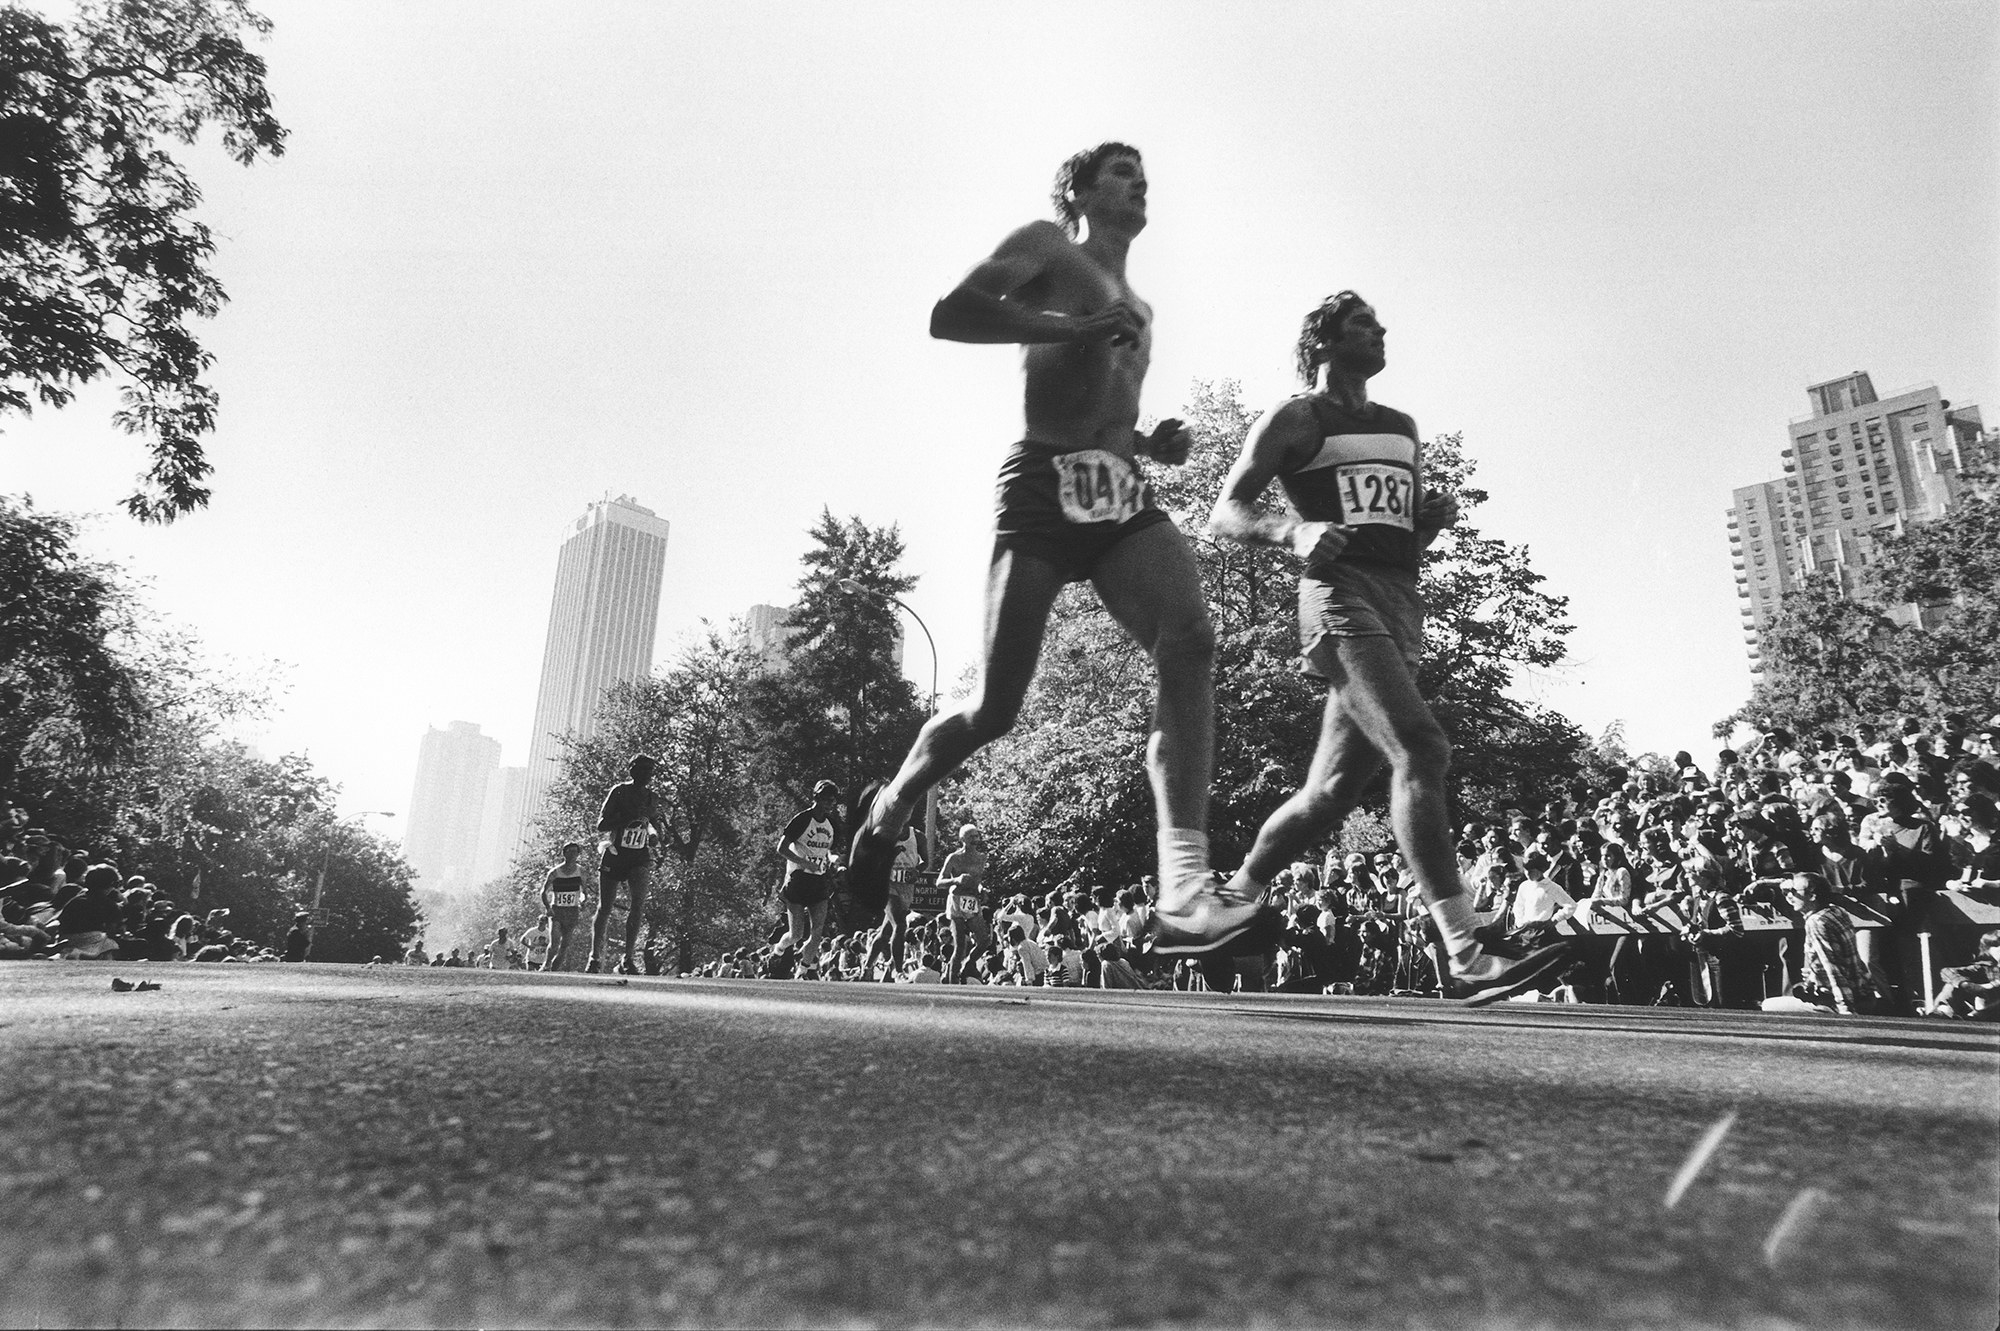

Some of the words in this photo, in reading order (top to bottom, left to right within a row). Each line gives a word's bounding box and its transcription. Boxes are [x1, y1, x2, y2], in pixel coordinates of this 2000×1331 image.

[1346, 474, 1411, 518] 1287
[806, 829, 816, 839] LE
[914, 877, 928, 885] ARK
[914, 887, 938, 895] NORTH
[558, 893, 576, 905] 1587
[912, 896, 924, 905] EEP
[928, 897, 945, 906] LEFT
